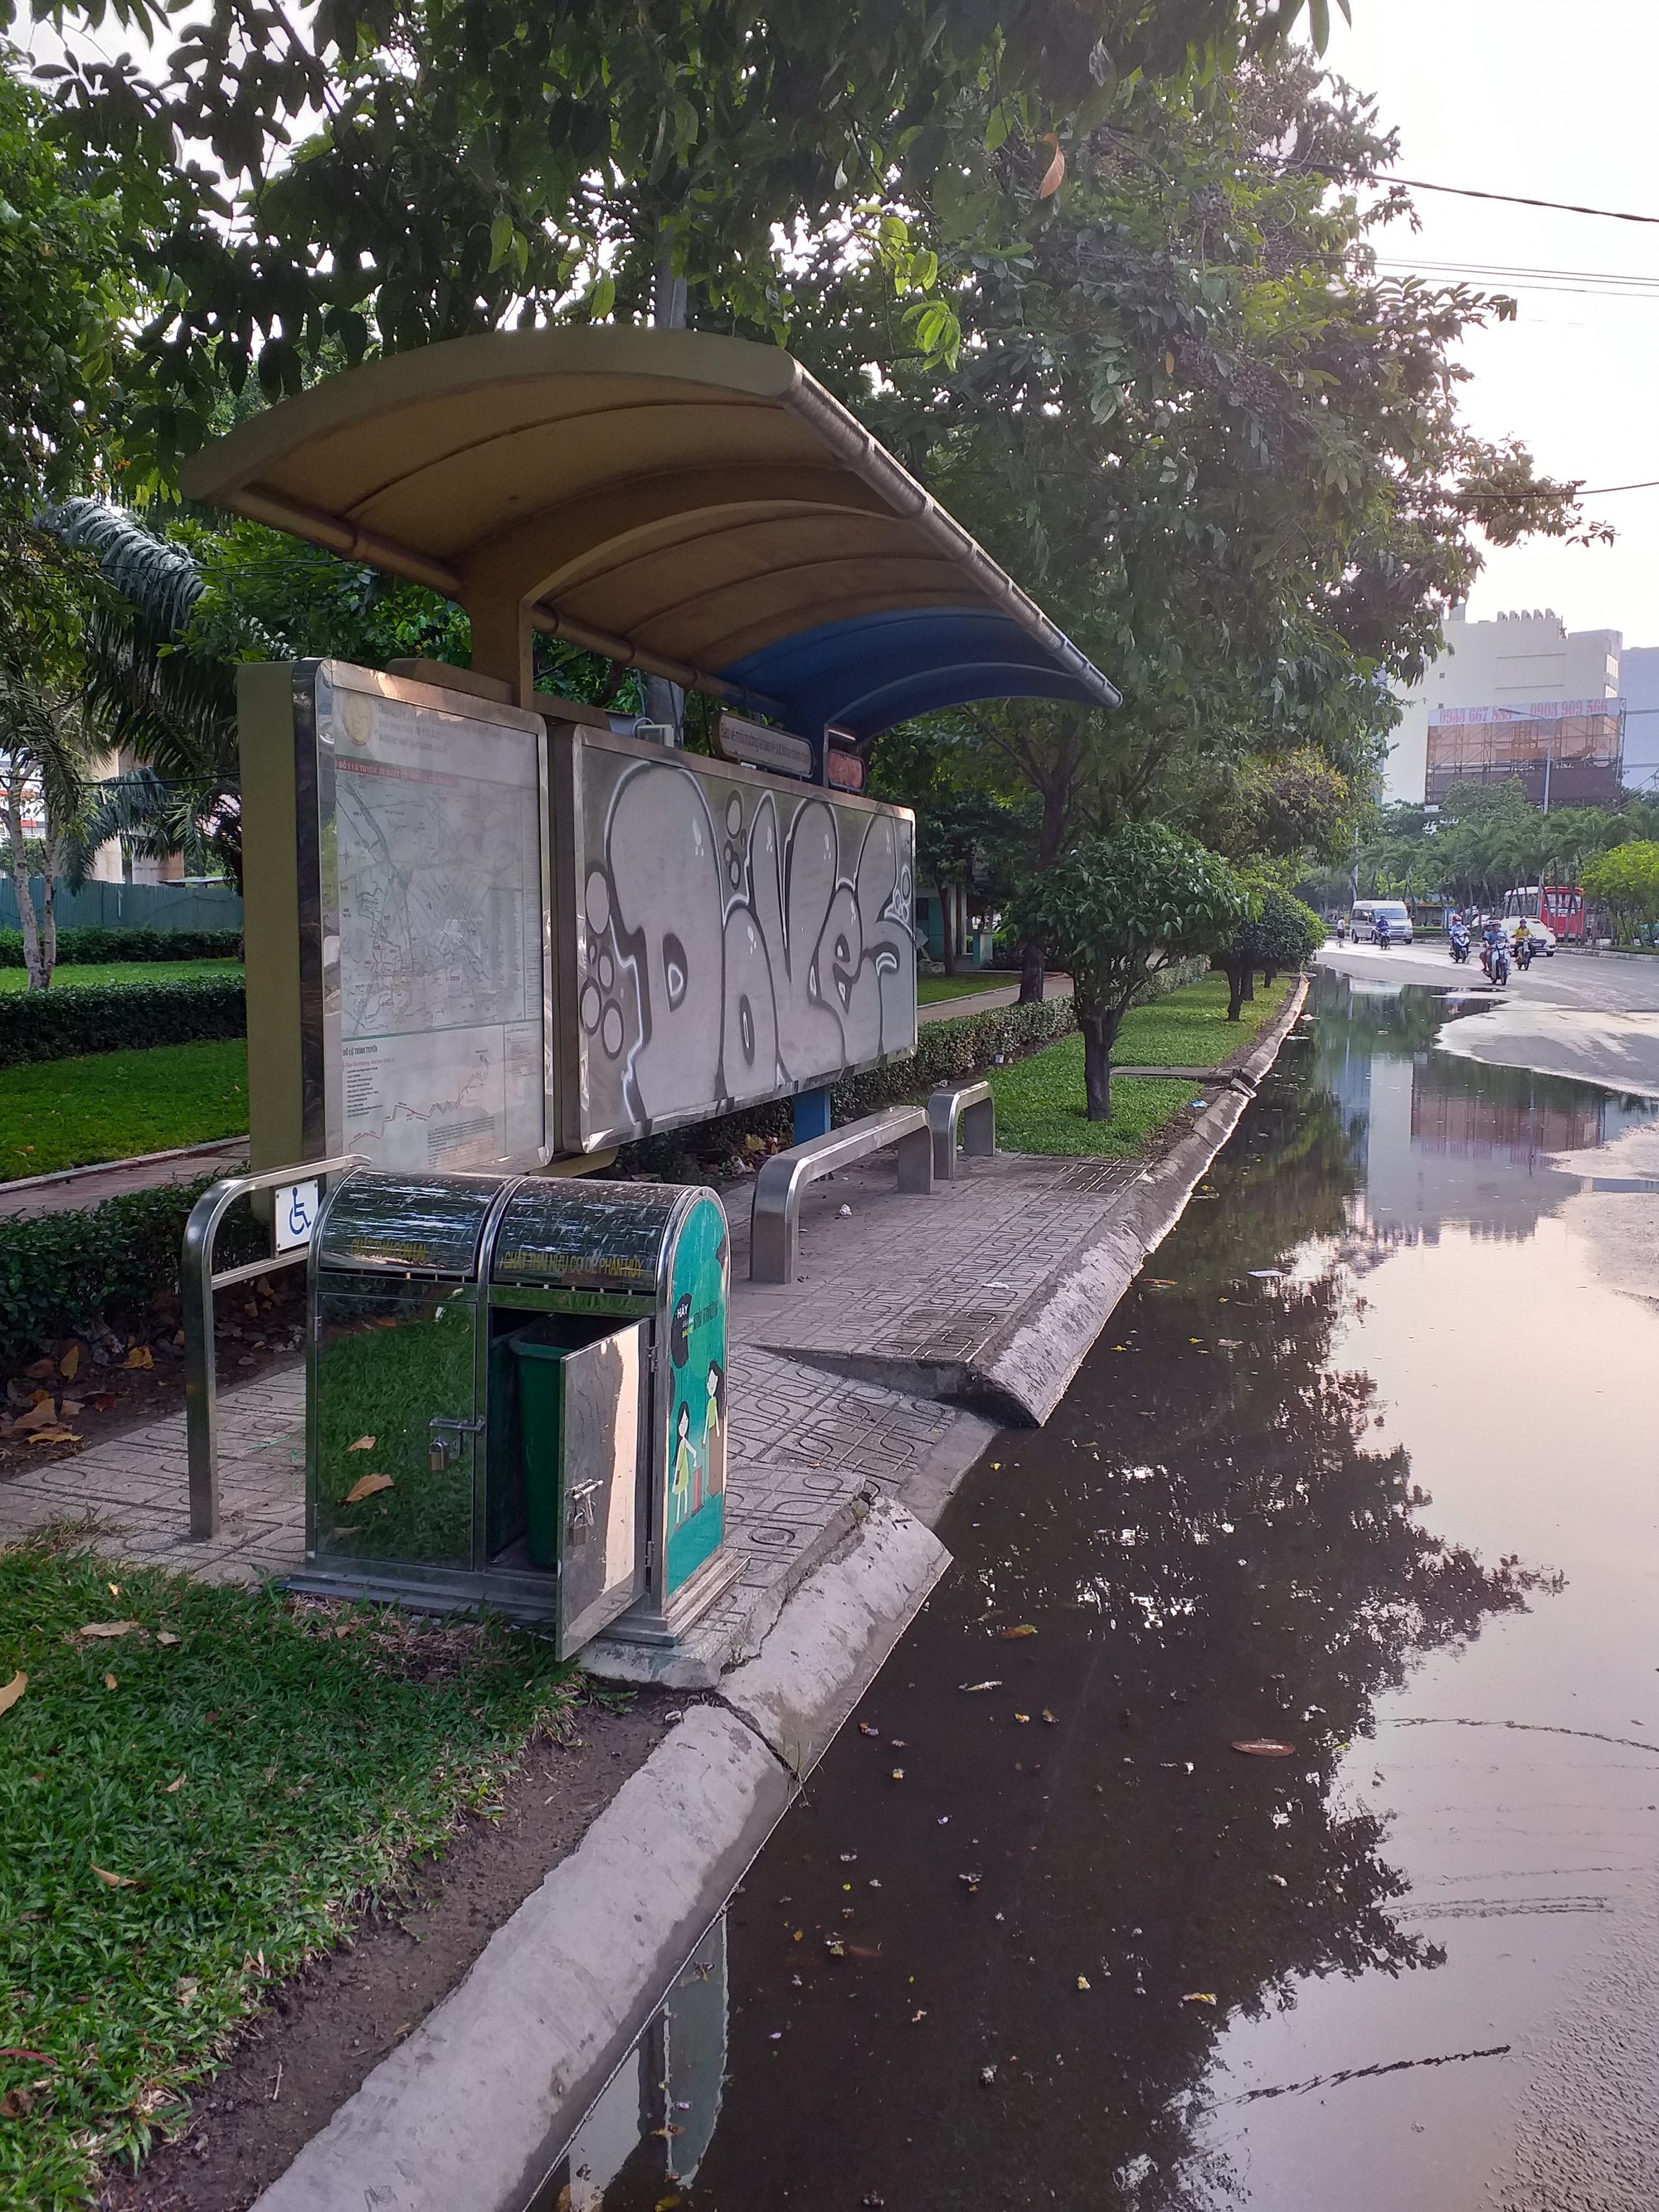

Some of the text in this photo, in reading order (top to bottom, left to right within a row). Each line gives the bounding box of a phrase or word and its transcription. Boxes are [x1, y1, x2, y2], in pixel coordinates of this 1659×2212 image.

[1440, 707, 1466, 724] 0933
[1468, 707, 1489, 722] 667
[1530, 702, 1558, 718] 0903
[1561, 700, 1583, 716] 909
[1586, 699, 1608, 714] 566
